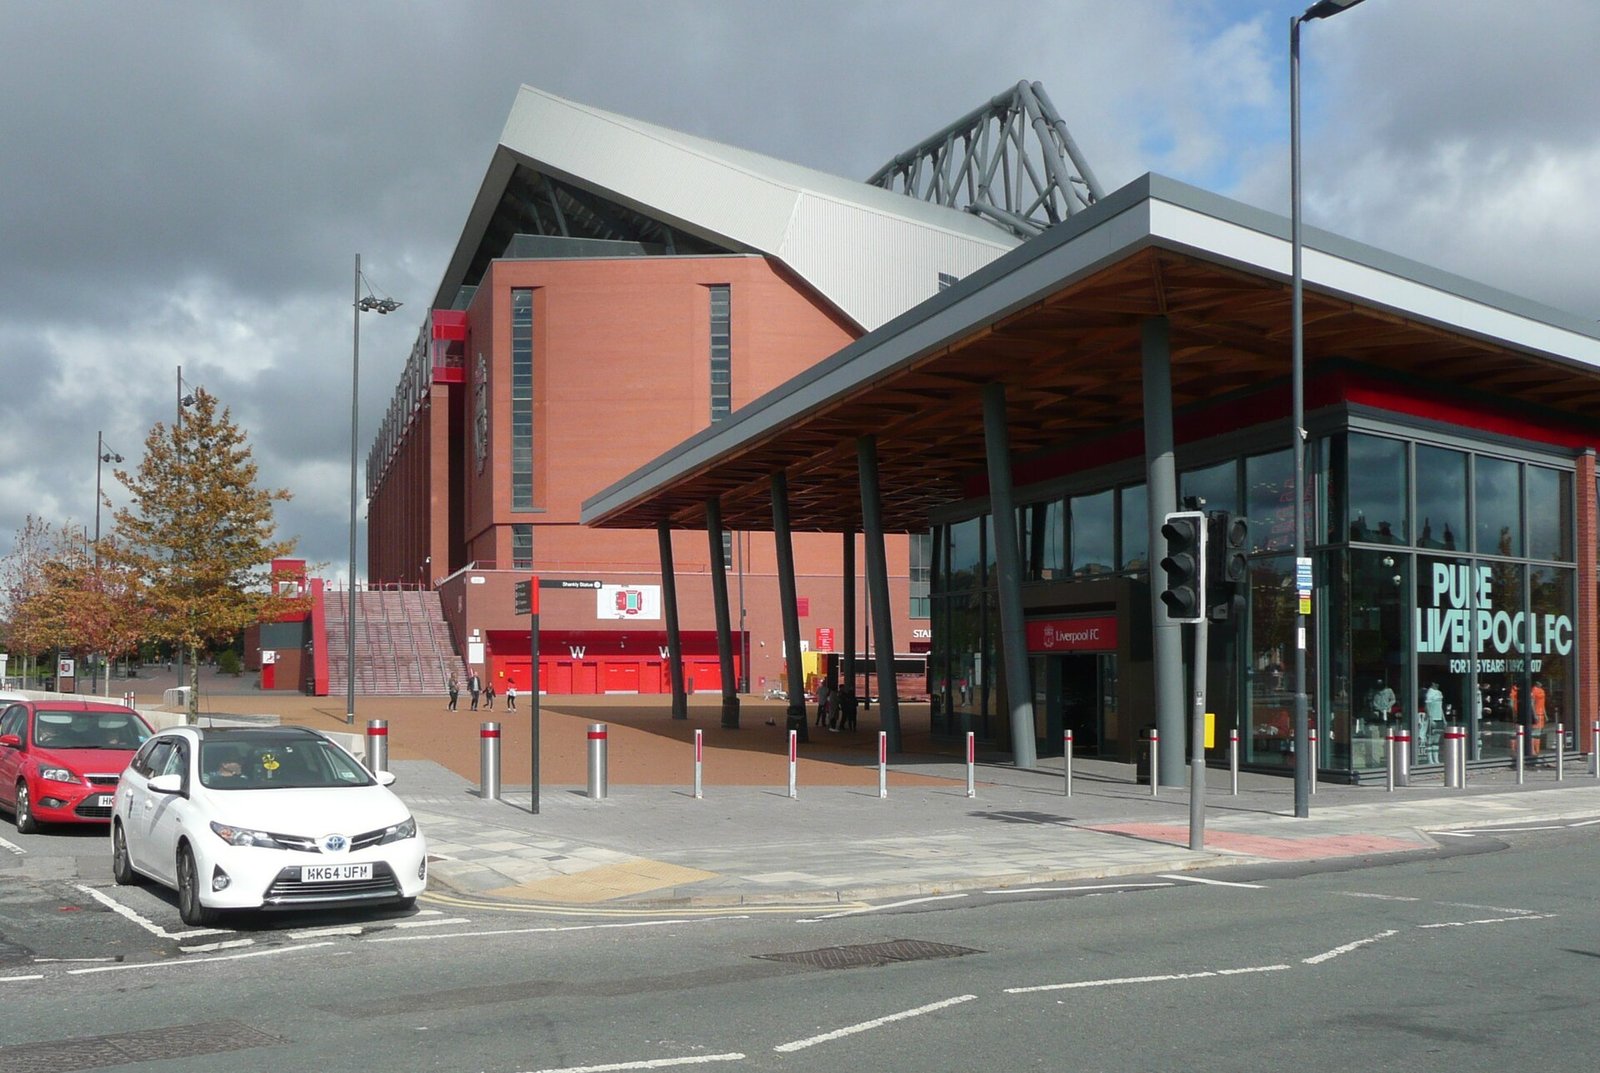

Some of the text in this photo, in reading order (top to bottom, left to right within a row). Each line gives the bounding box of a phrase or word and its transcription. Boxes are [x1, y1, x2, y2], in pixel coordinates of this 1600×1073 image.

[1433, 562, 1492, 609] PURE
[1055, 628, 1099, 644] Liverpool FC
[1545, 613, 1573, 656] FC
[569, 645, 586, 659] W
[1450, 659, 1466, 673] FOR
[1467, 659, 1481, 673] 15
[1481, 659, 1505, 673] YEARS
